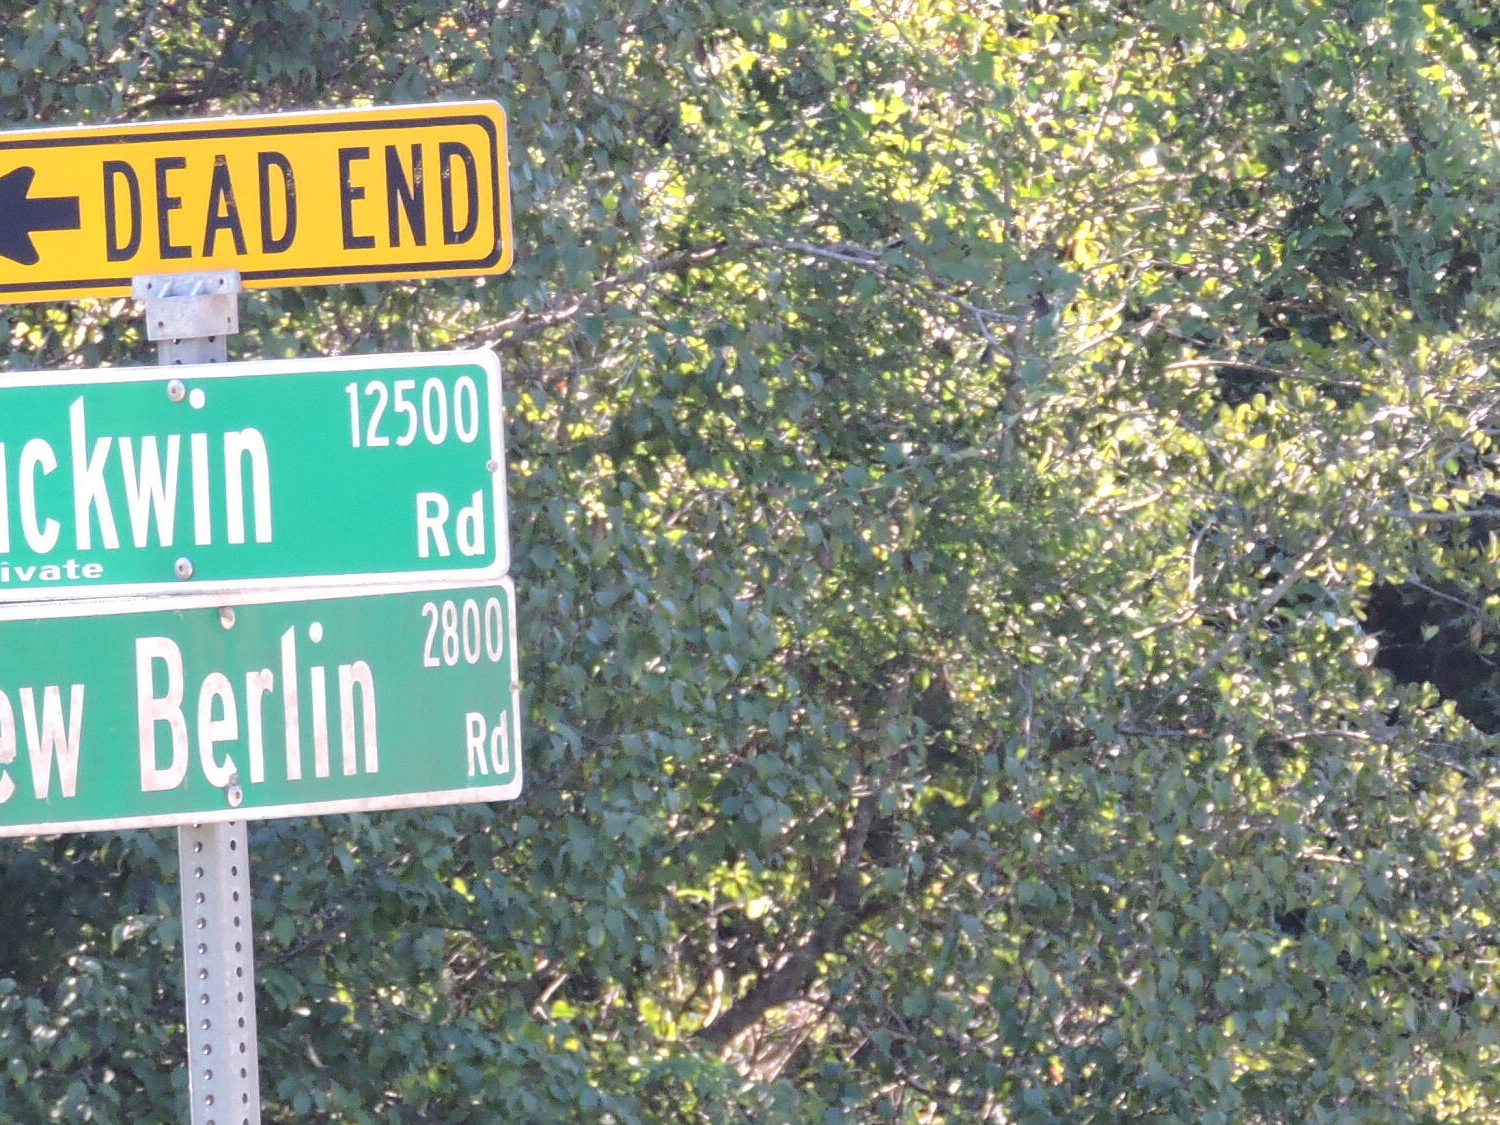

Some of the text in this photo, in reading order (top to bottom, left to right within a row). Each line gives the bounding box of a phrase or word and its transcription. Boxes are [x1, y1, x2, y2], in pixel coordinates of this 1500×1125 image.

[103, 141, 480, 262] DEAD END
[346, 376, 480, 448] 12500
[417, 489, 486, 558] Rd
[422, 597, 502, 667] 2800
[135, 621, 379, 792] Berlin
[466, 710, 510, 777] Rd
